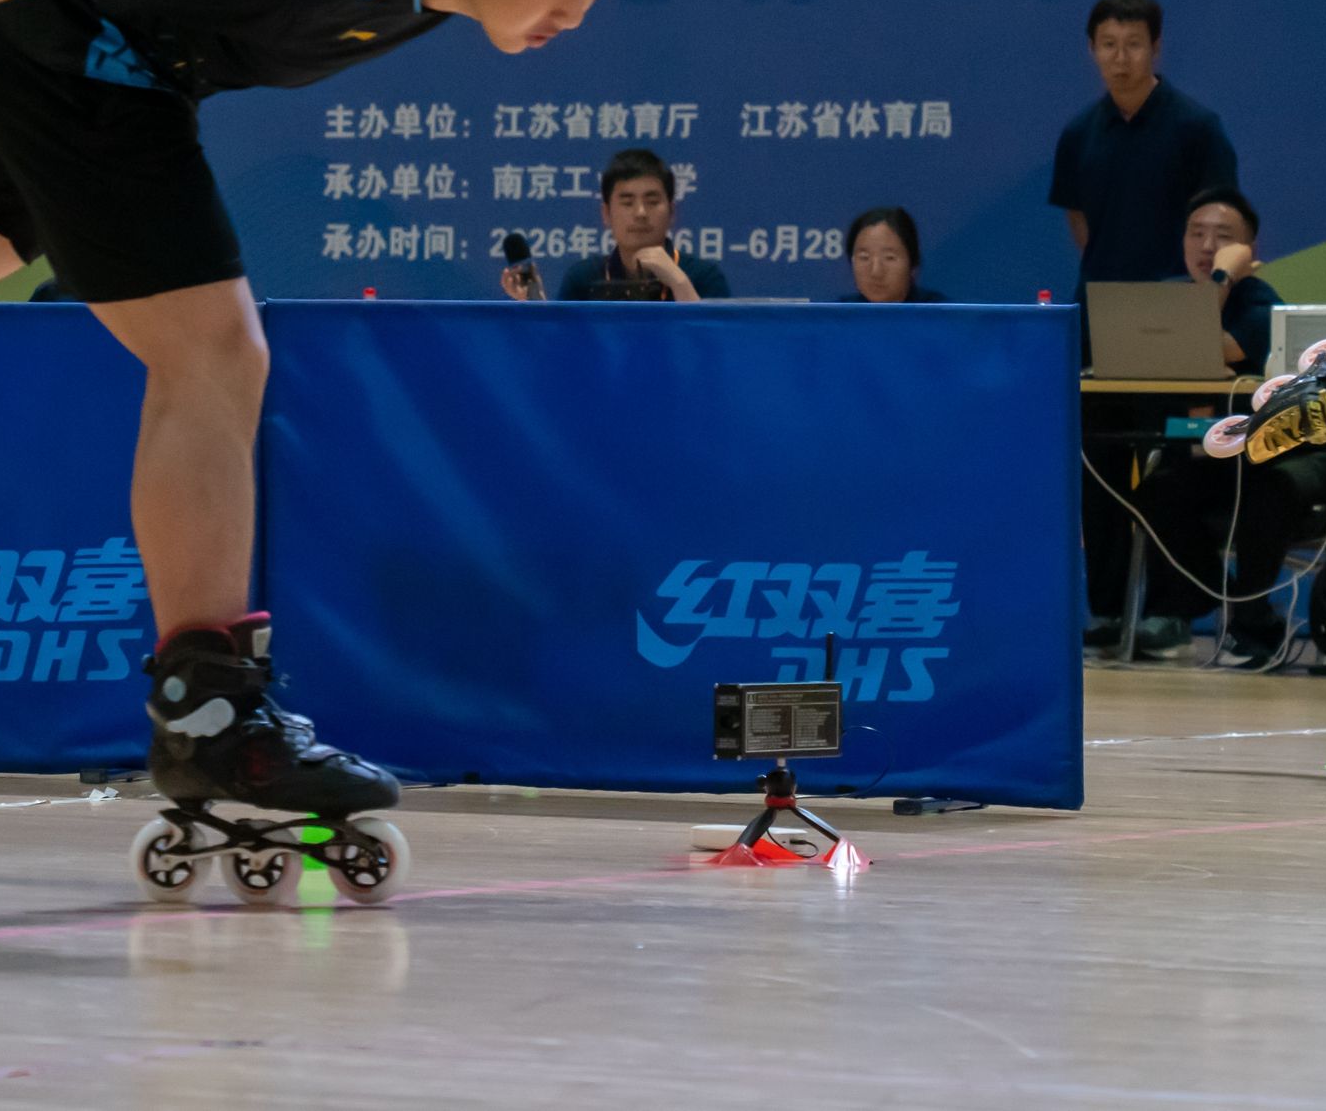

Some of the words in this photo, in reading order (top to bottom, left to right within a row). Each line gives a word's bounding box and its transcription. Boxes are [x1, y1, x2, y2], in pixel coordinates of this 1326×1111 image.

[741, 101, 952, 139] 江苏省体育局
[637, 551, 961, 668] 红双喜
